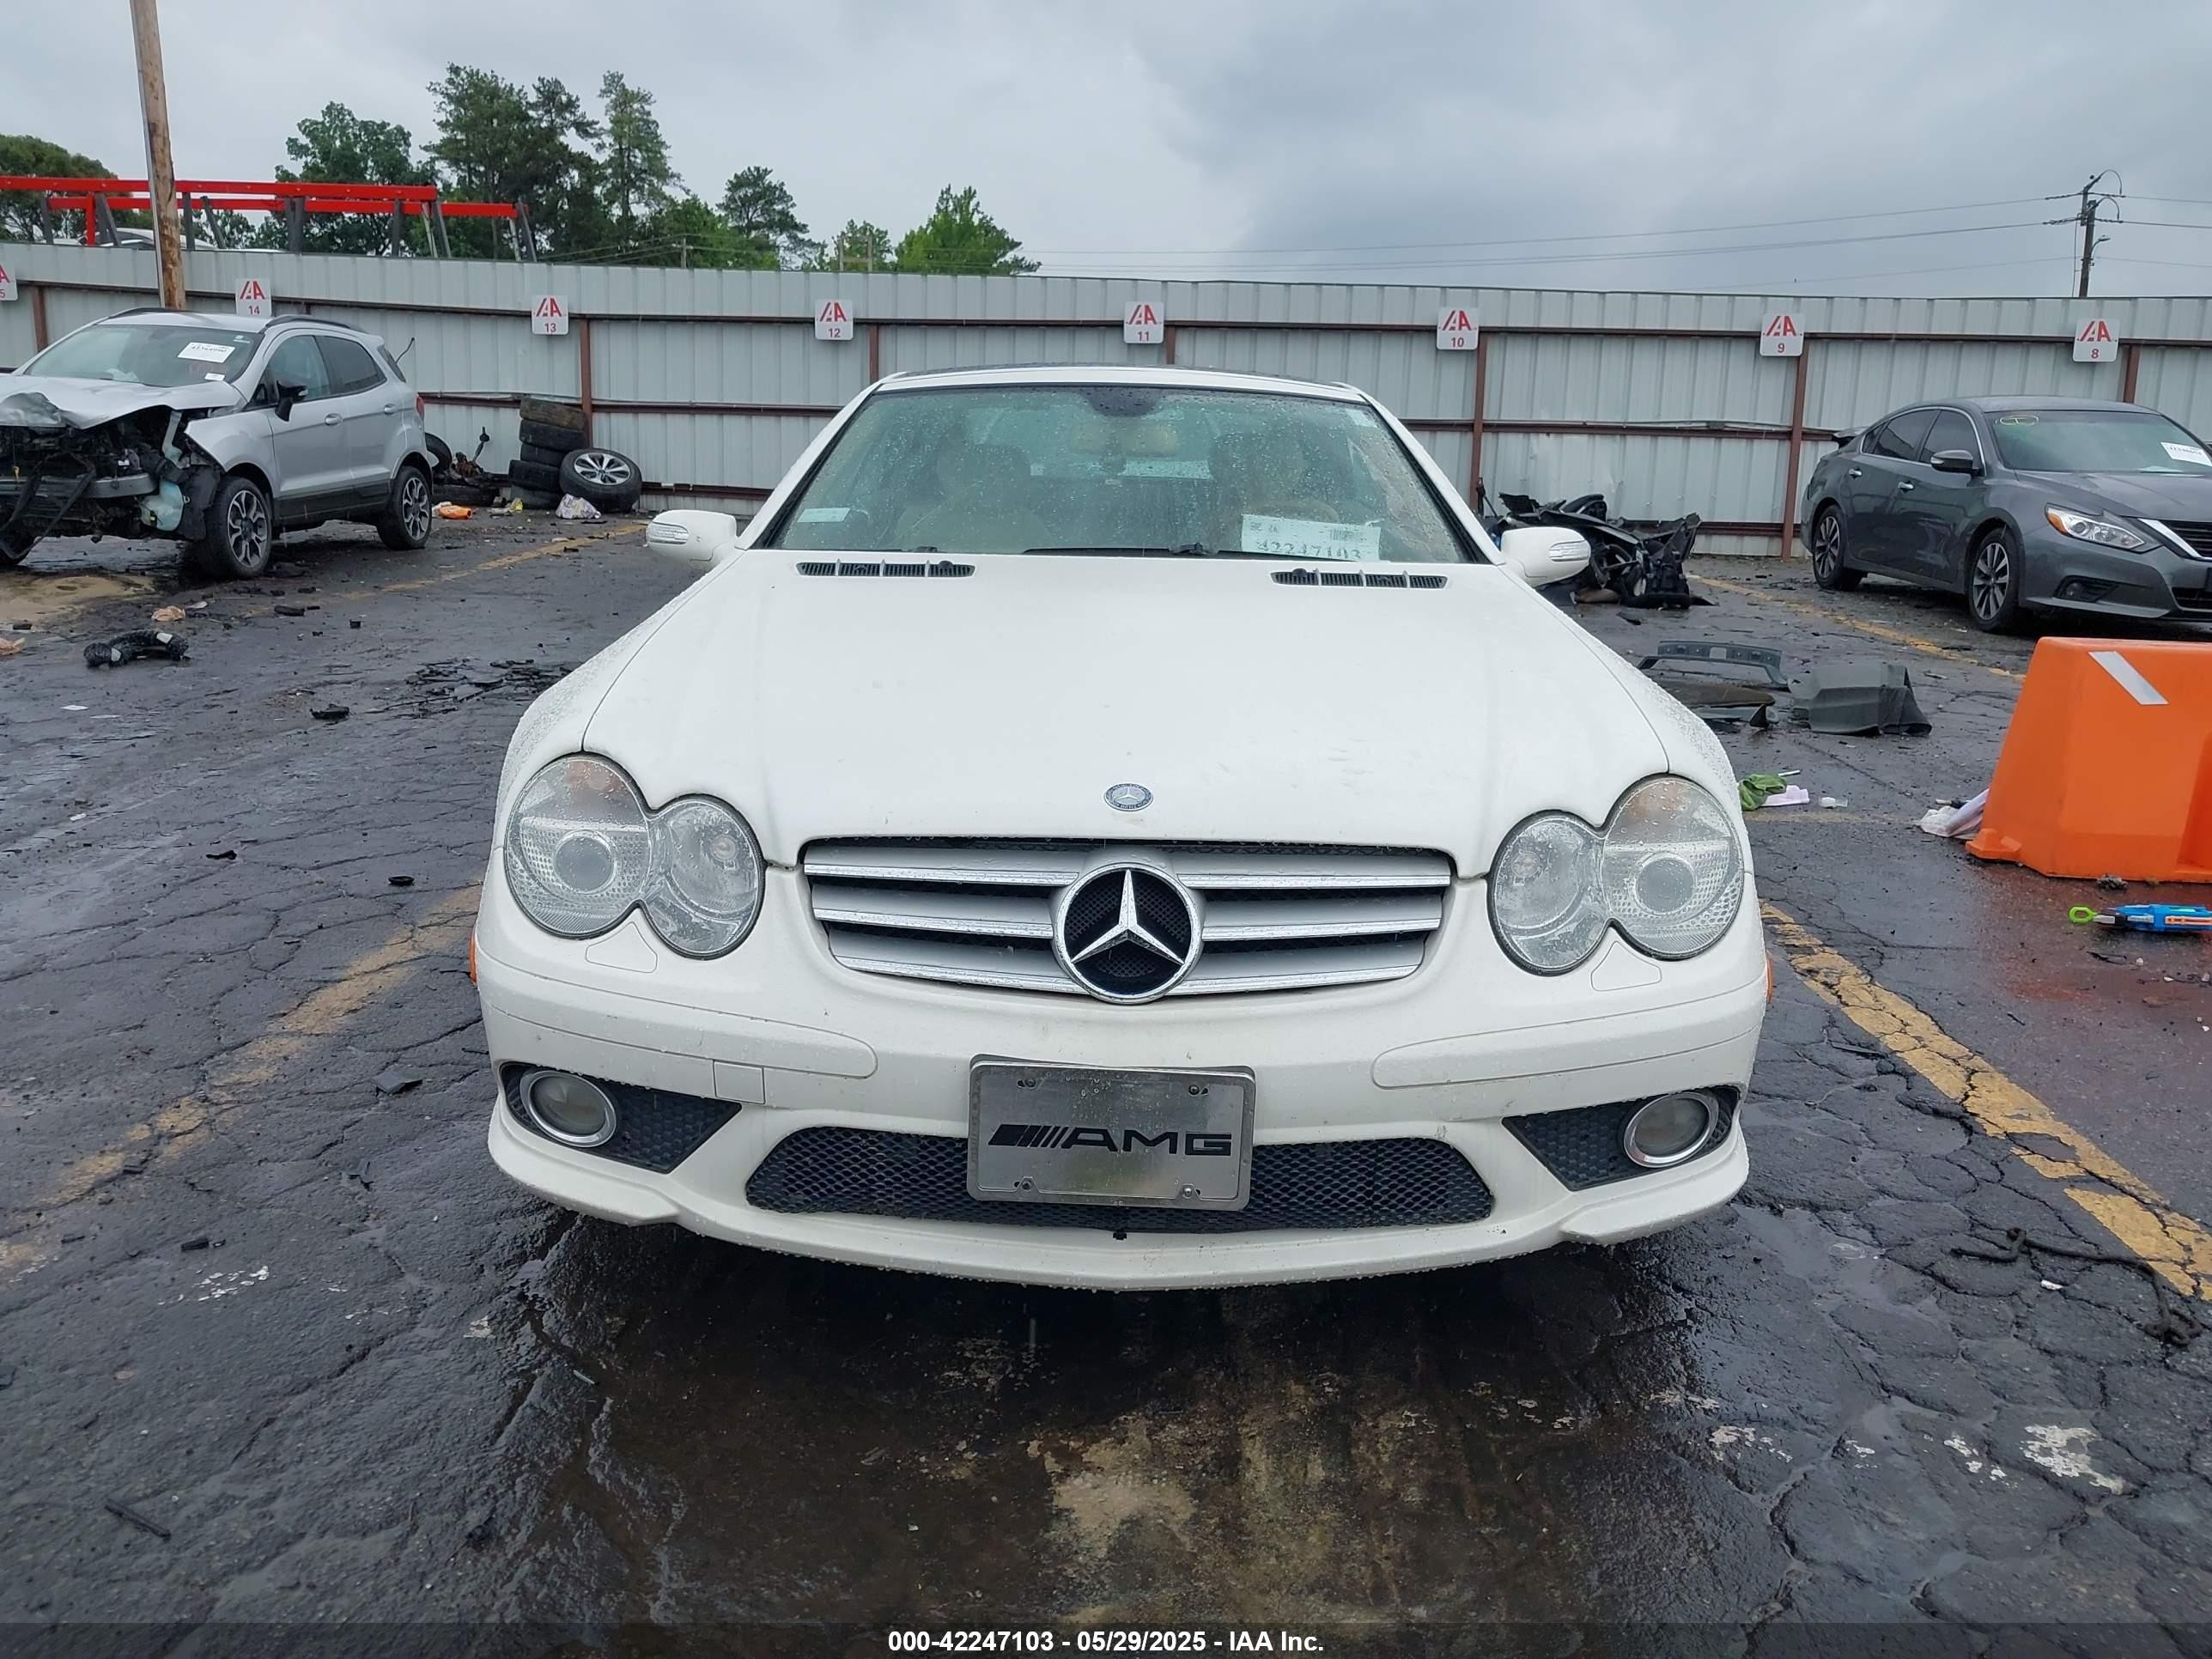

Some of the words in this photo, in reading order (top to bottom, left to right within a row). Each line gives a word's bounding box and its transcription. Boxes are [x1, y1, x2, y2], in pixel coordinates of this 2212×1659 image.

[248, 305, 260, 315] 14
[544, 323, 556, 333] 13
[828, 328, 841, 338] 12
[1137, 331, 1149, 342] 11
[1450, 337, 1464, 348] 10
[1778, 343, 1785, 354] 9
[2091, 349, 2099, 359] 8
[1061, 1127, 1232, 1157] AMG
